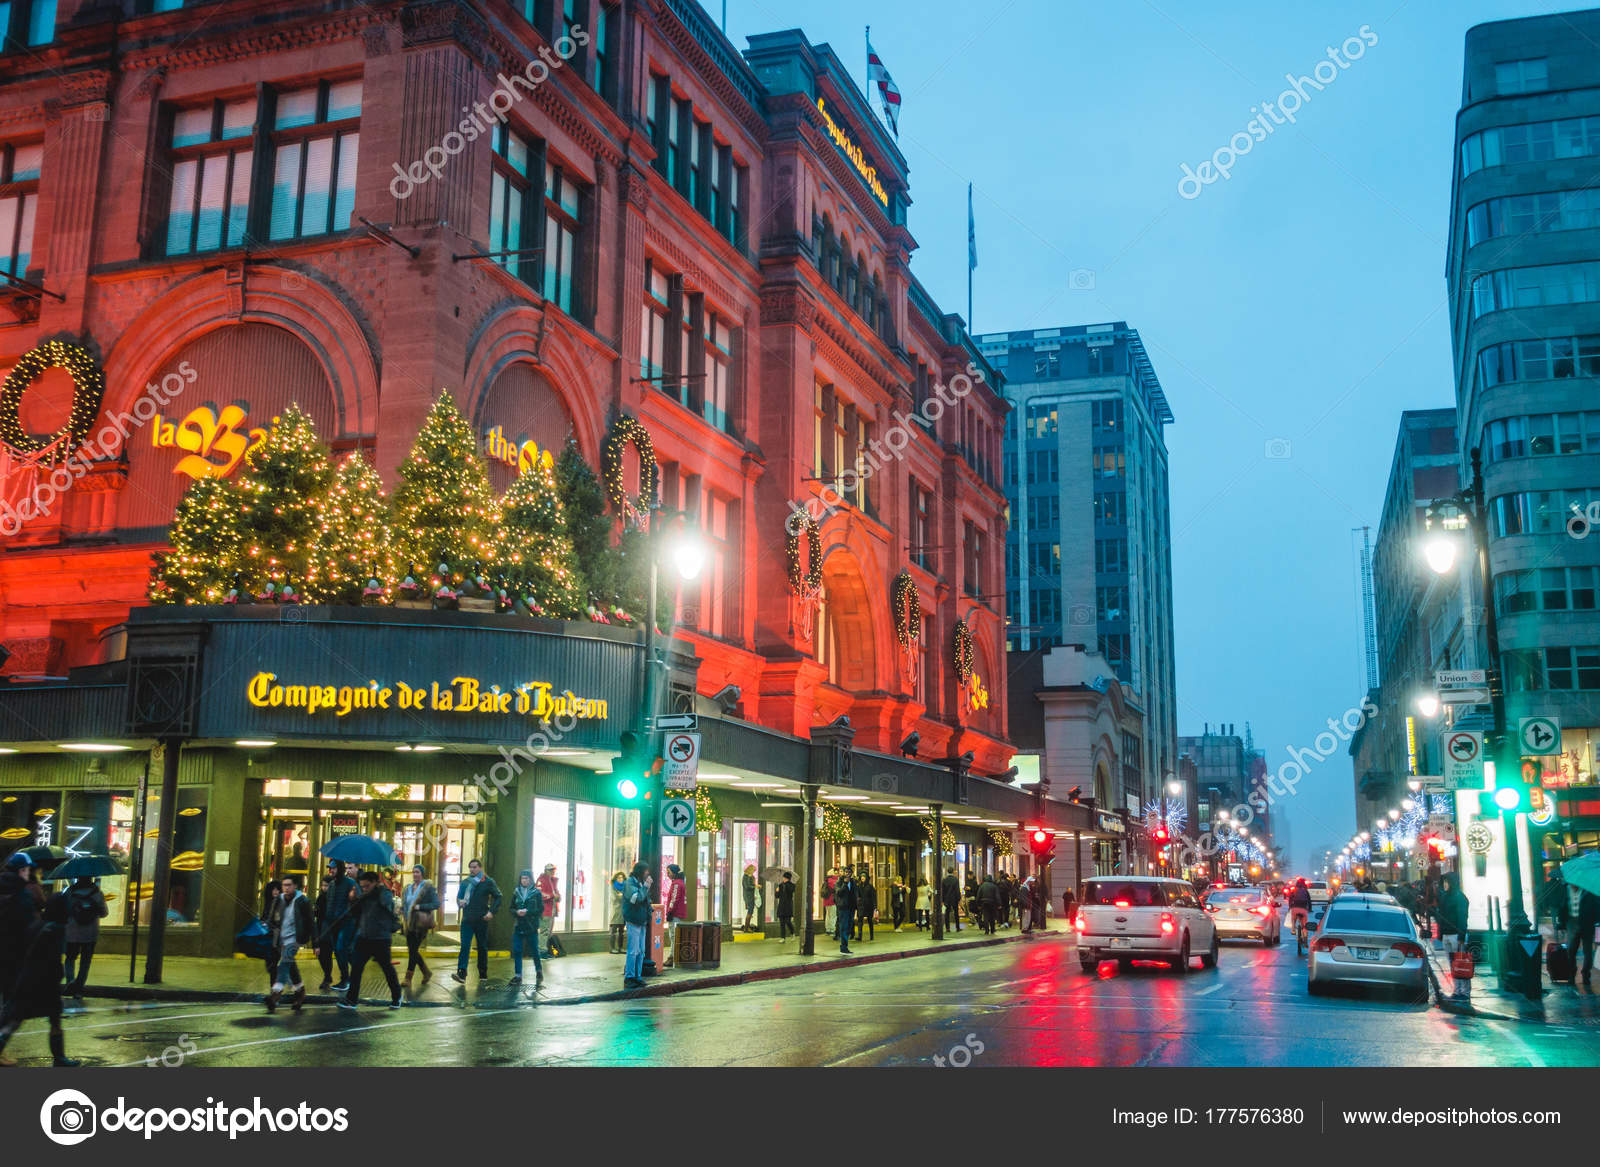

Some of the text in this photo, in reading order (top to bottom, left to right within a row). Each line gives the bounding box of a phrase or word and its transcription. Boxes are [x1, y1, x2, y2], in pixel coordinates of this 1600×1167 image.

[152, 414, 176, 448] la
[489, 425, 518, 466] the
[248, 671, 392, 716] Compagnie
[396, 681, 427, 710] de
[1439, 675, 1468, 683] Union
